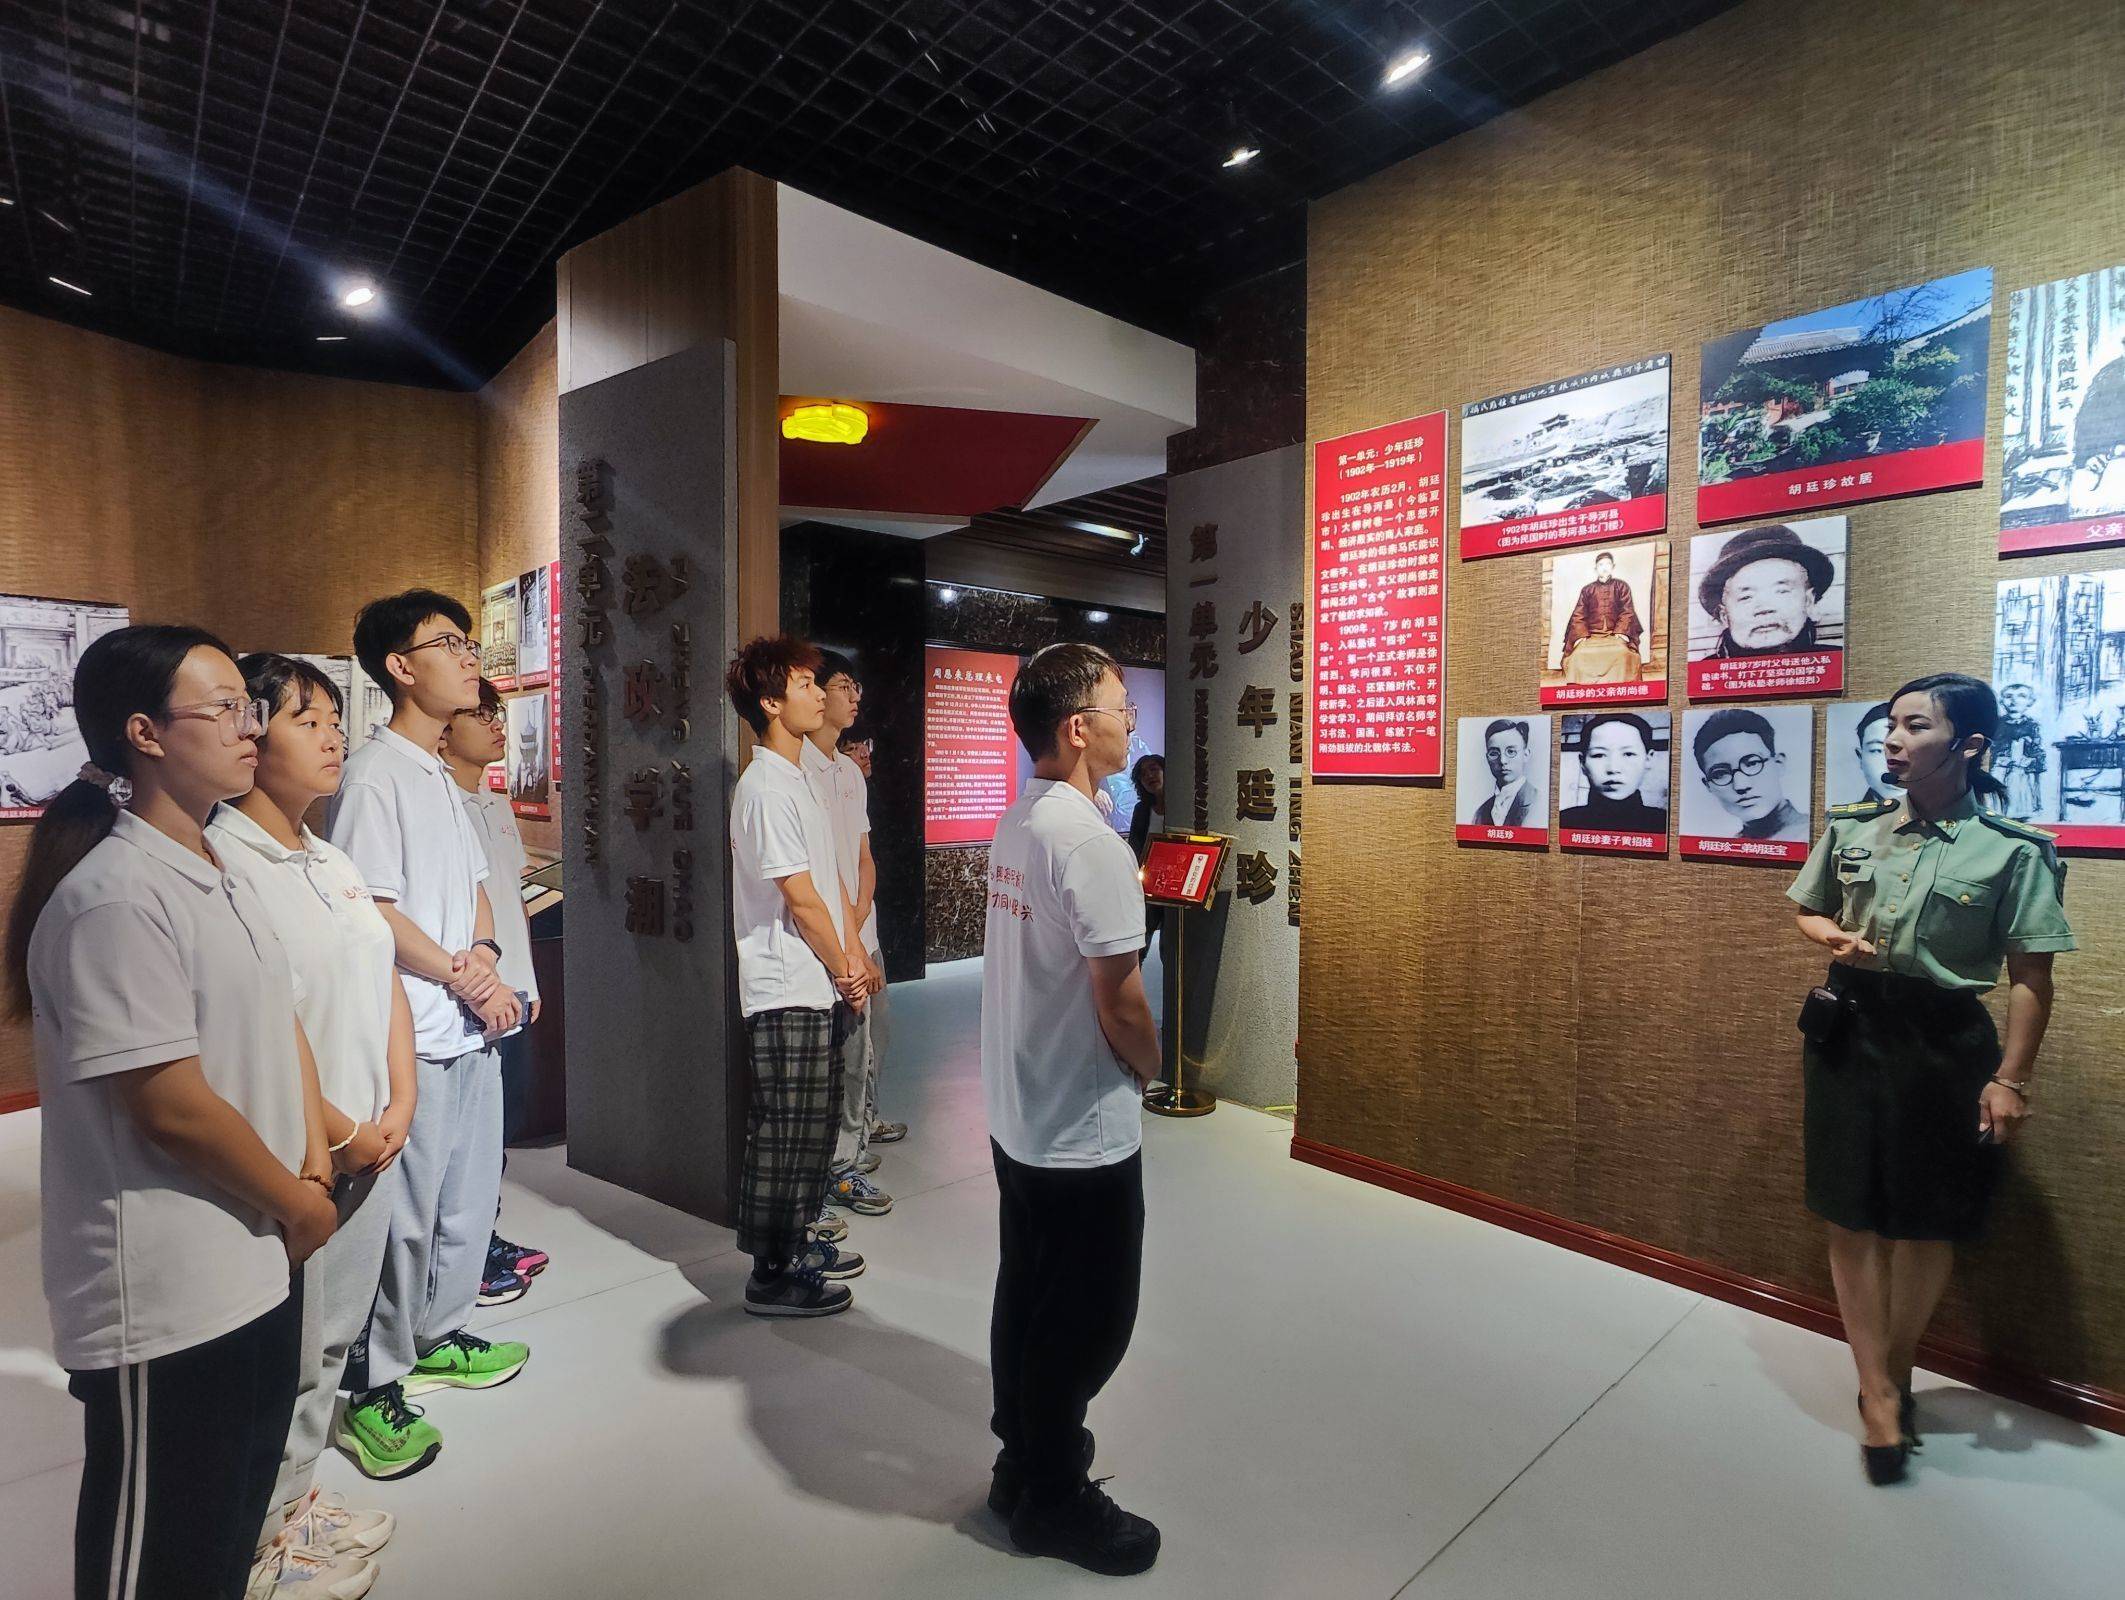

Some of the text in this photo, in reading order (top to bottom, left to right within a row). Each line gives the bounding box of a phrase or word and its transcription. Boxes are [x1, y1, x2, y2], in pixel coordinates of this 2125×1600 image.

[1788, 472, 1873, 495] 胡廷珍故居
[1502, 509, 1619, 535] 1902年胡廷珍出生于导河县
[1189, 524, 1218, 680] 第一单元
[1720, 655, 1831, 671] 胡廷珍7岁时父母送他入私
[1556, 685, 1648, 699] 胡廷珍的父亲胡尚德
[1237, 600, 1278, 906] 少年廷珍
[1487, 828, 1514, 840] 胡廷珍
[1571, 833, 1653, 848] 胡廷珍妻子黄招娃
[1698, 840, 1789, 856] 胡廷珍二弟胡廷宝
